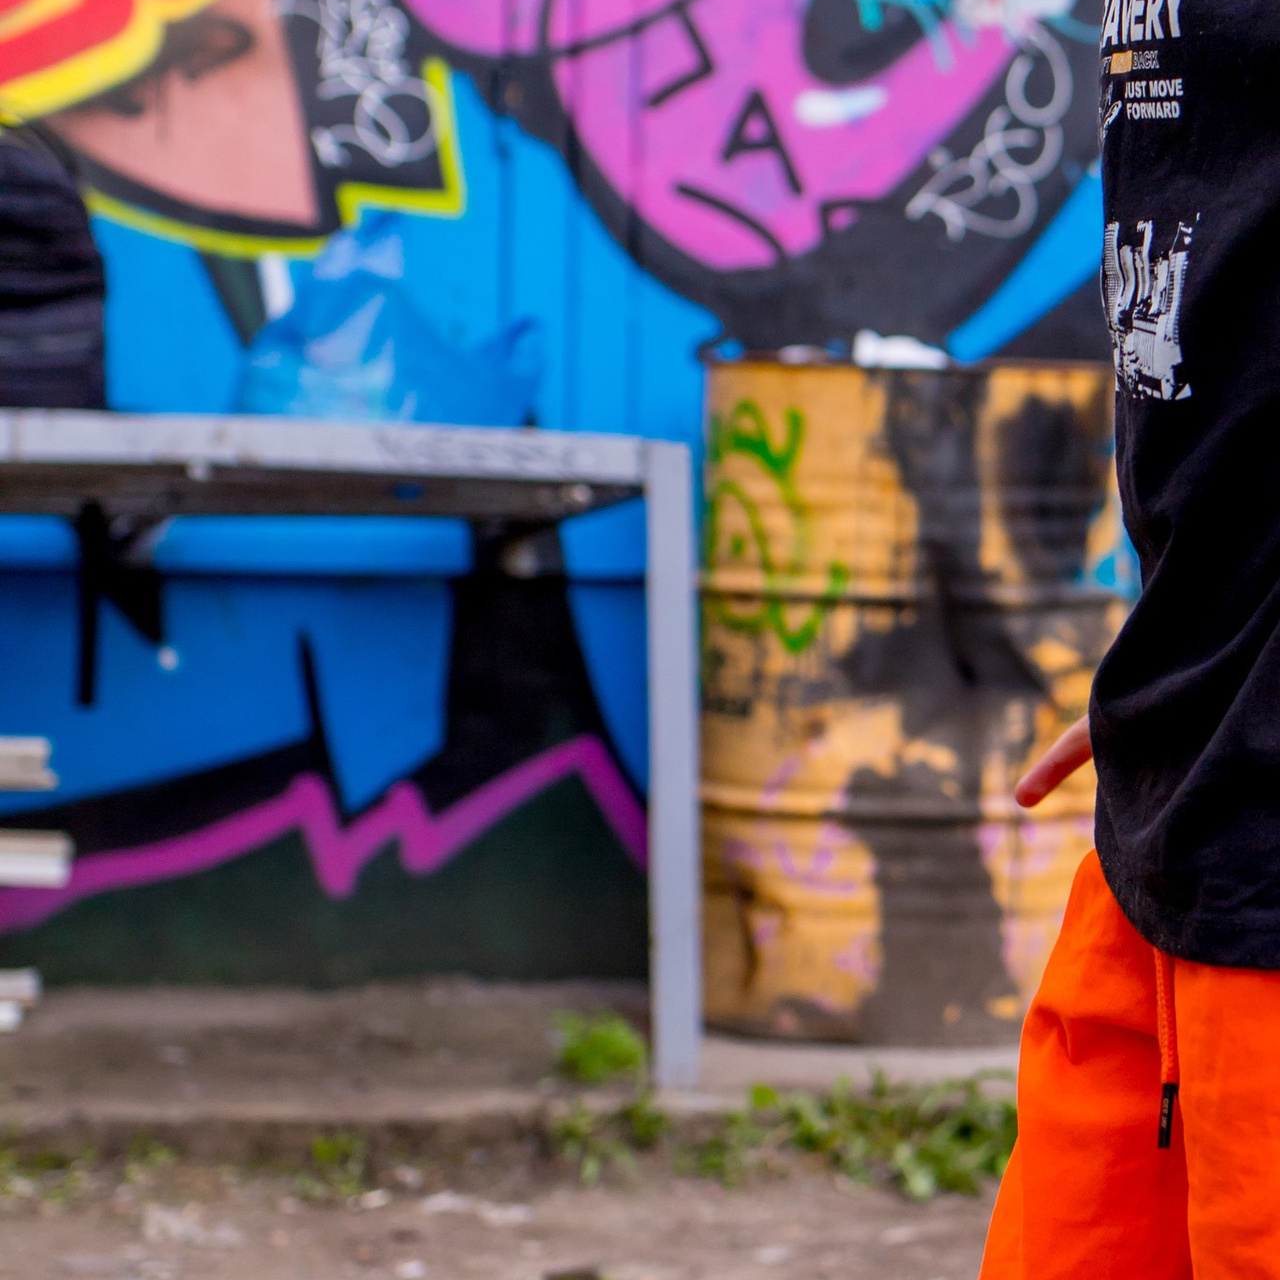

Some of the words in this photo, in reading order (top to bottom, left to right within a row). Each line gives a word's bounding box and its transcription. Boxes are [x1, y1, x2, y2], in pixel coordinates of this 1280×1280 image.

[1132, 50, 1160, 70] BACK
[1124, 79, 1147, 99] JUST
[1149, 77, 1184, 98] MOVE
[1126, 101, 1181, 120] FORWARD
